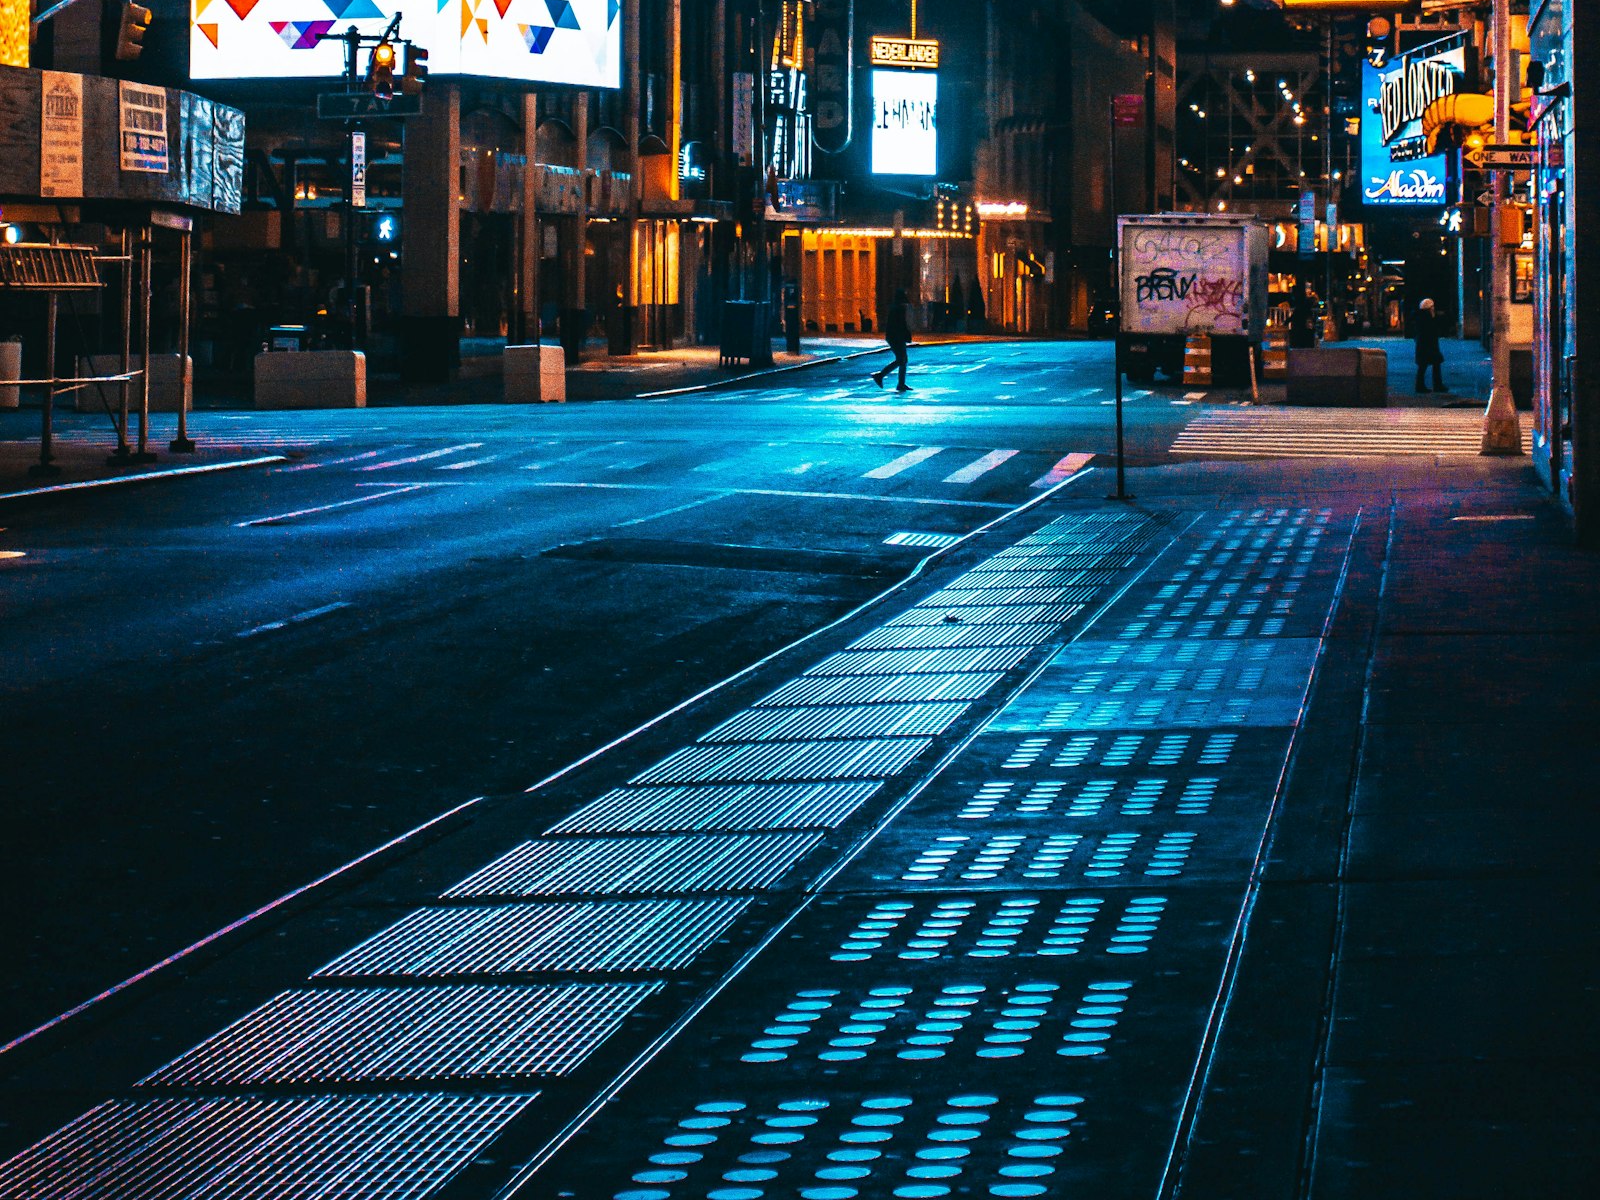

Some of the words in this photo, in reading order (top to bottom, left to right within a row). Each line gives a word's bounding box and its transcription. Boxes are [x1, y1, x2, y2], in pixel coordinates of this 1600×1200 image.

[871, 42, 939, 63] NEDERLANDER
[349, 97, 360, 113] 7
[1379, 76, 1404, 149] RED
[1472, 152, 1496, 162] ONE
[1509, 153, 1535, 162] WAY
[354, 163, 364, 182] 25
[1364, 169, 1446, 199] Aladdin
